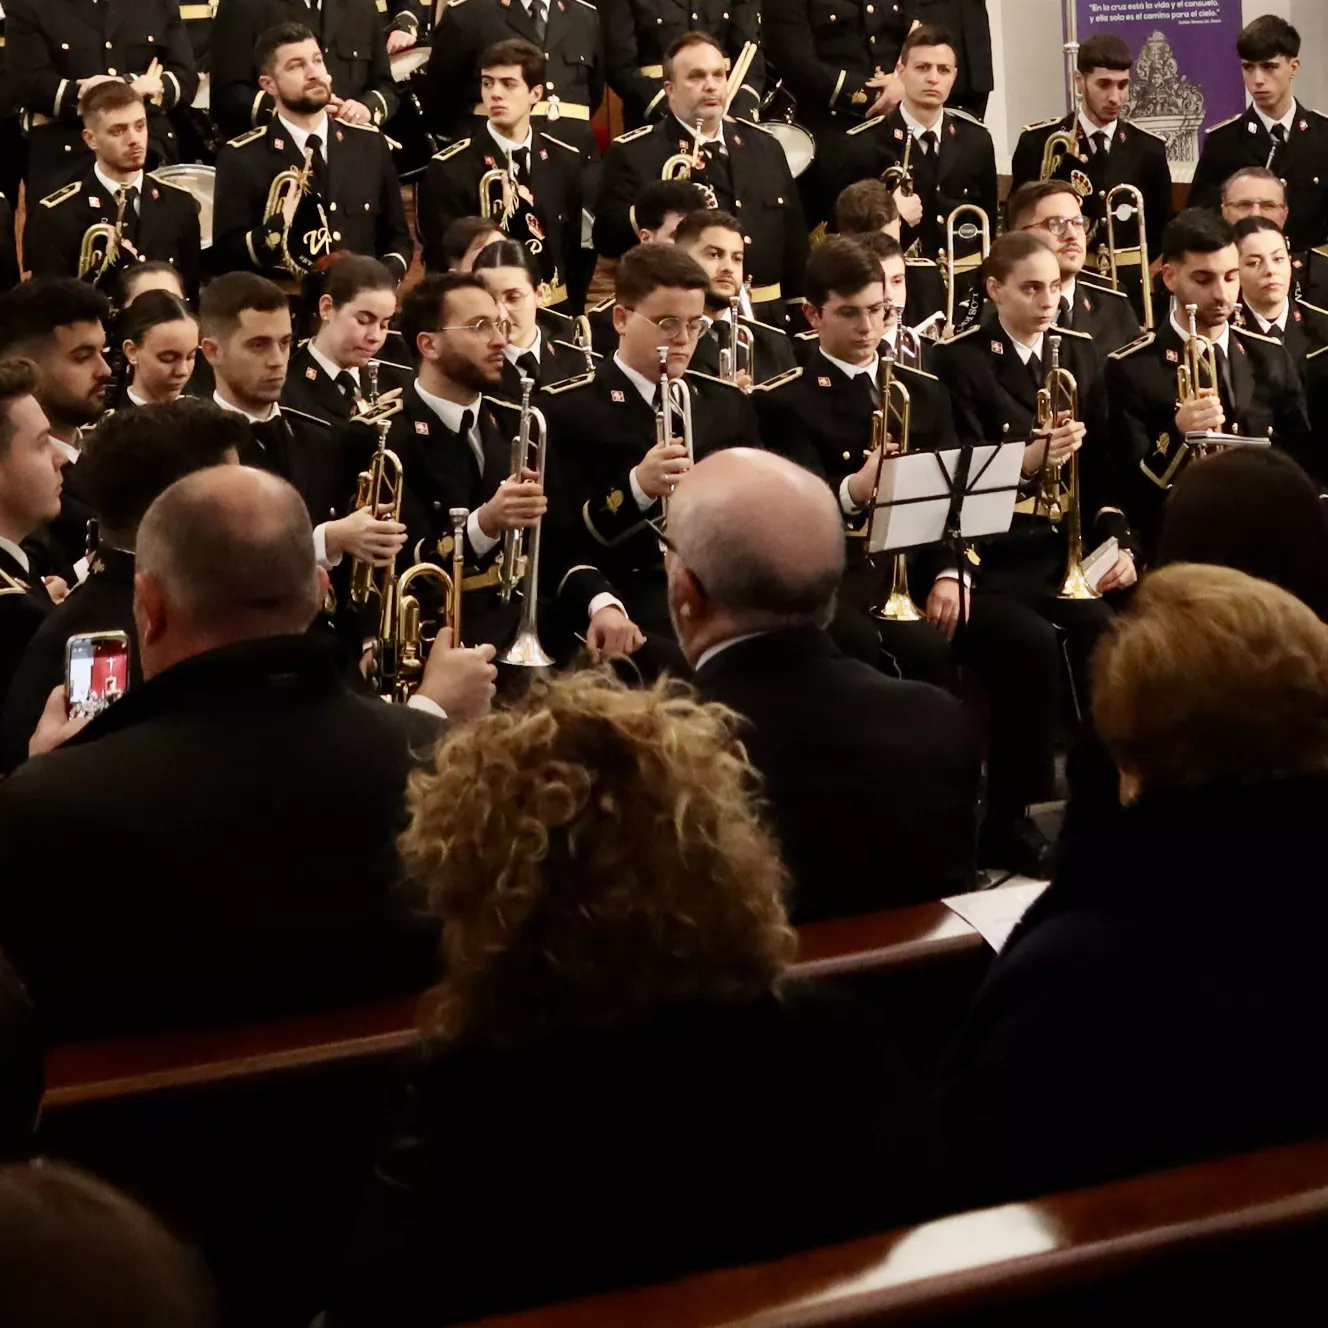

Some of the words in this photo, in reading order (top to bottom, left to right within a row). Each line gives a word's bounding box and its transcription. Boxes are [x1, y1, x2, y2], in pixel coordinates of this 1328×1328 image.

[1103, 3, 1110, 11] la
[1145, 1, 1153, 10] la
[1154, 0, 1170, 9] vida
[1171, 1, 1176, 9] y
[1177, 0, 1184, 8] el
[1089, 15, 1094, 24] y
[1095, 14, 1109, 22] ella
[1109, 13, 1125, 21] sola
[1136, 12, 1142, 20] el
[1143, 12, 1170, 20] camino
[1171, 11, 1189, 19] para
[1190, 9, 1198, 18] el
